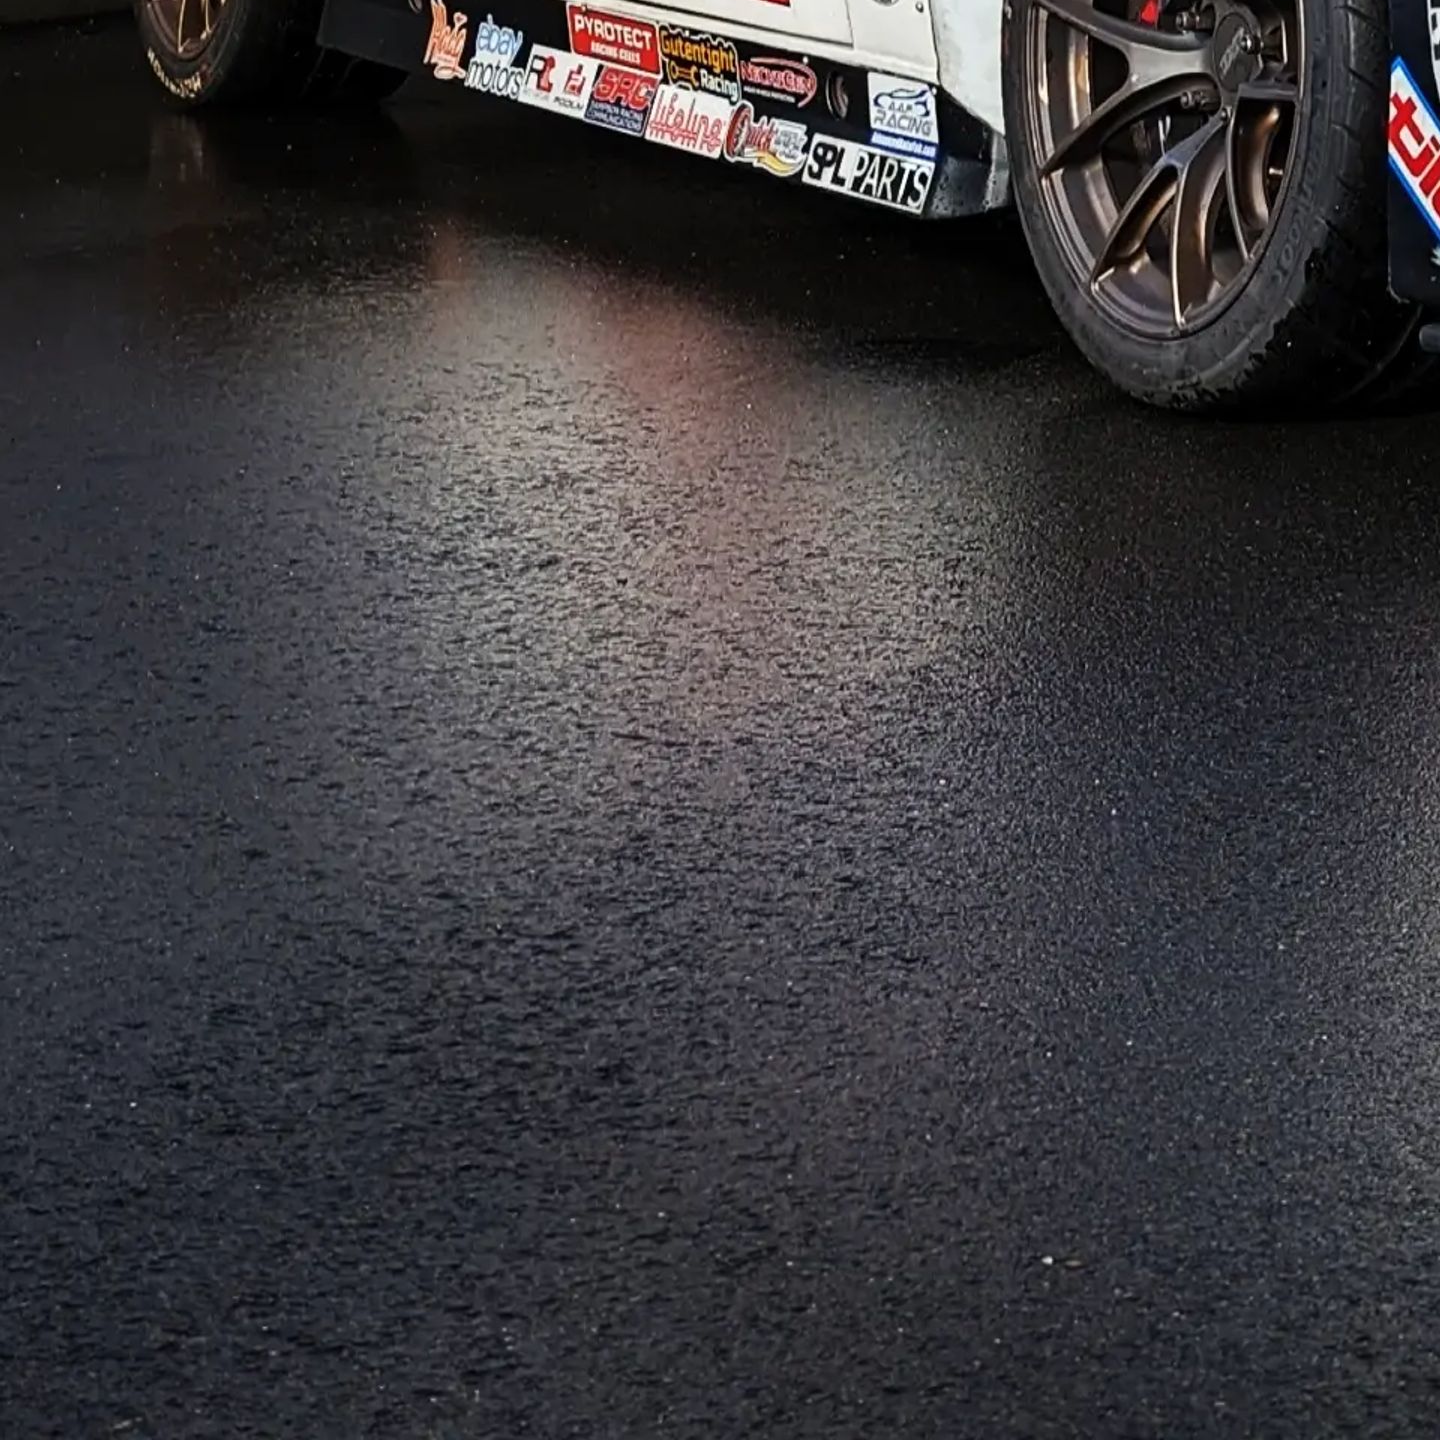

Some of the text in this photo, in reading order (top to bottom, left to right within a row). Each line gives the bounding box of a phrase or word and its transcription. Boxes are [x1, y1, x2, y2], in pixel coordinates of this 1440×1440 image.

[478, 14, 523, 62] ebay
[574, 14, 653, 51] PYROTECT
[659, 31, 736, 73] Gutentight
[468, 59, 525, 98] motors
[593, 67, 658, 110] SRC
[700, 69, 739, 102] Racing
[873, 108, 934, 137] RACING
[807, 142, 846, 187] SPL
[850, 148, 932, 207] PARTS
